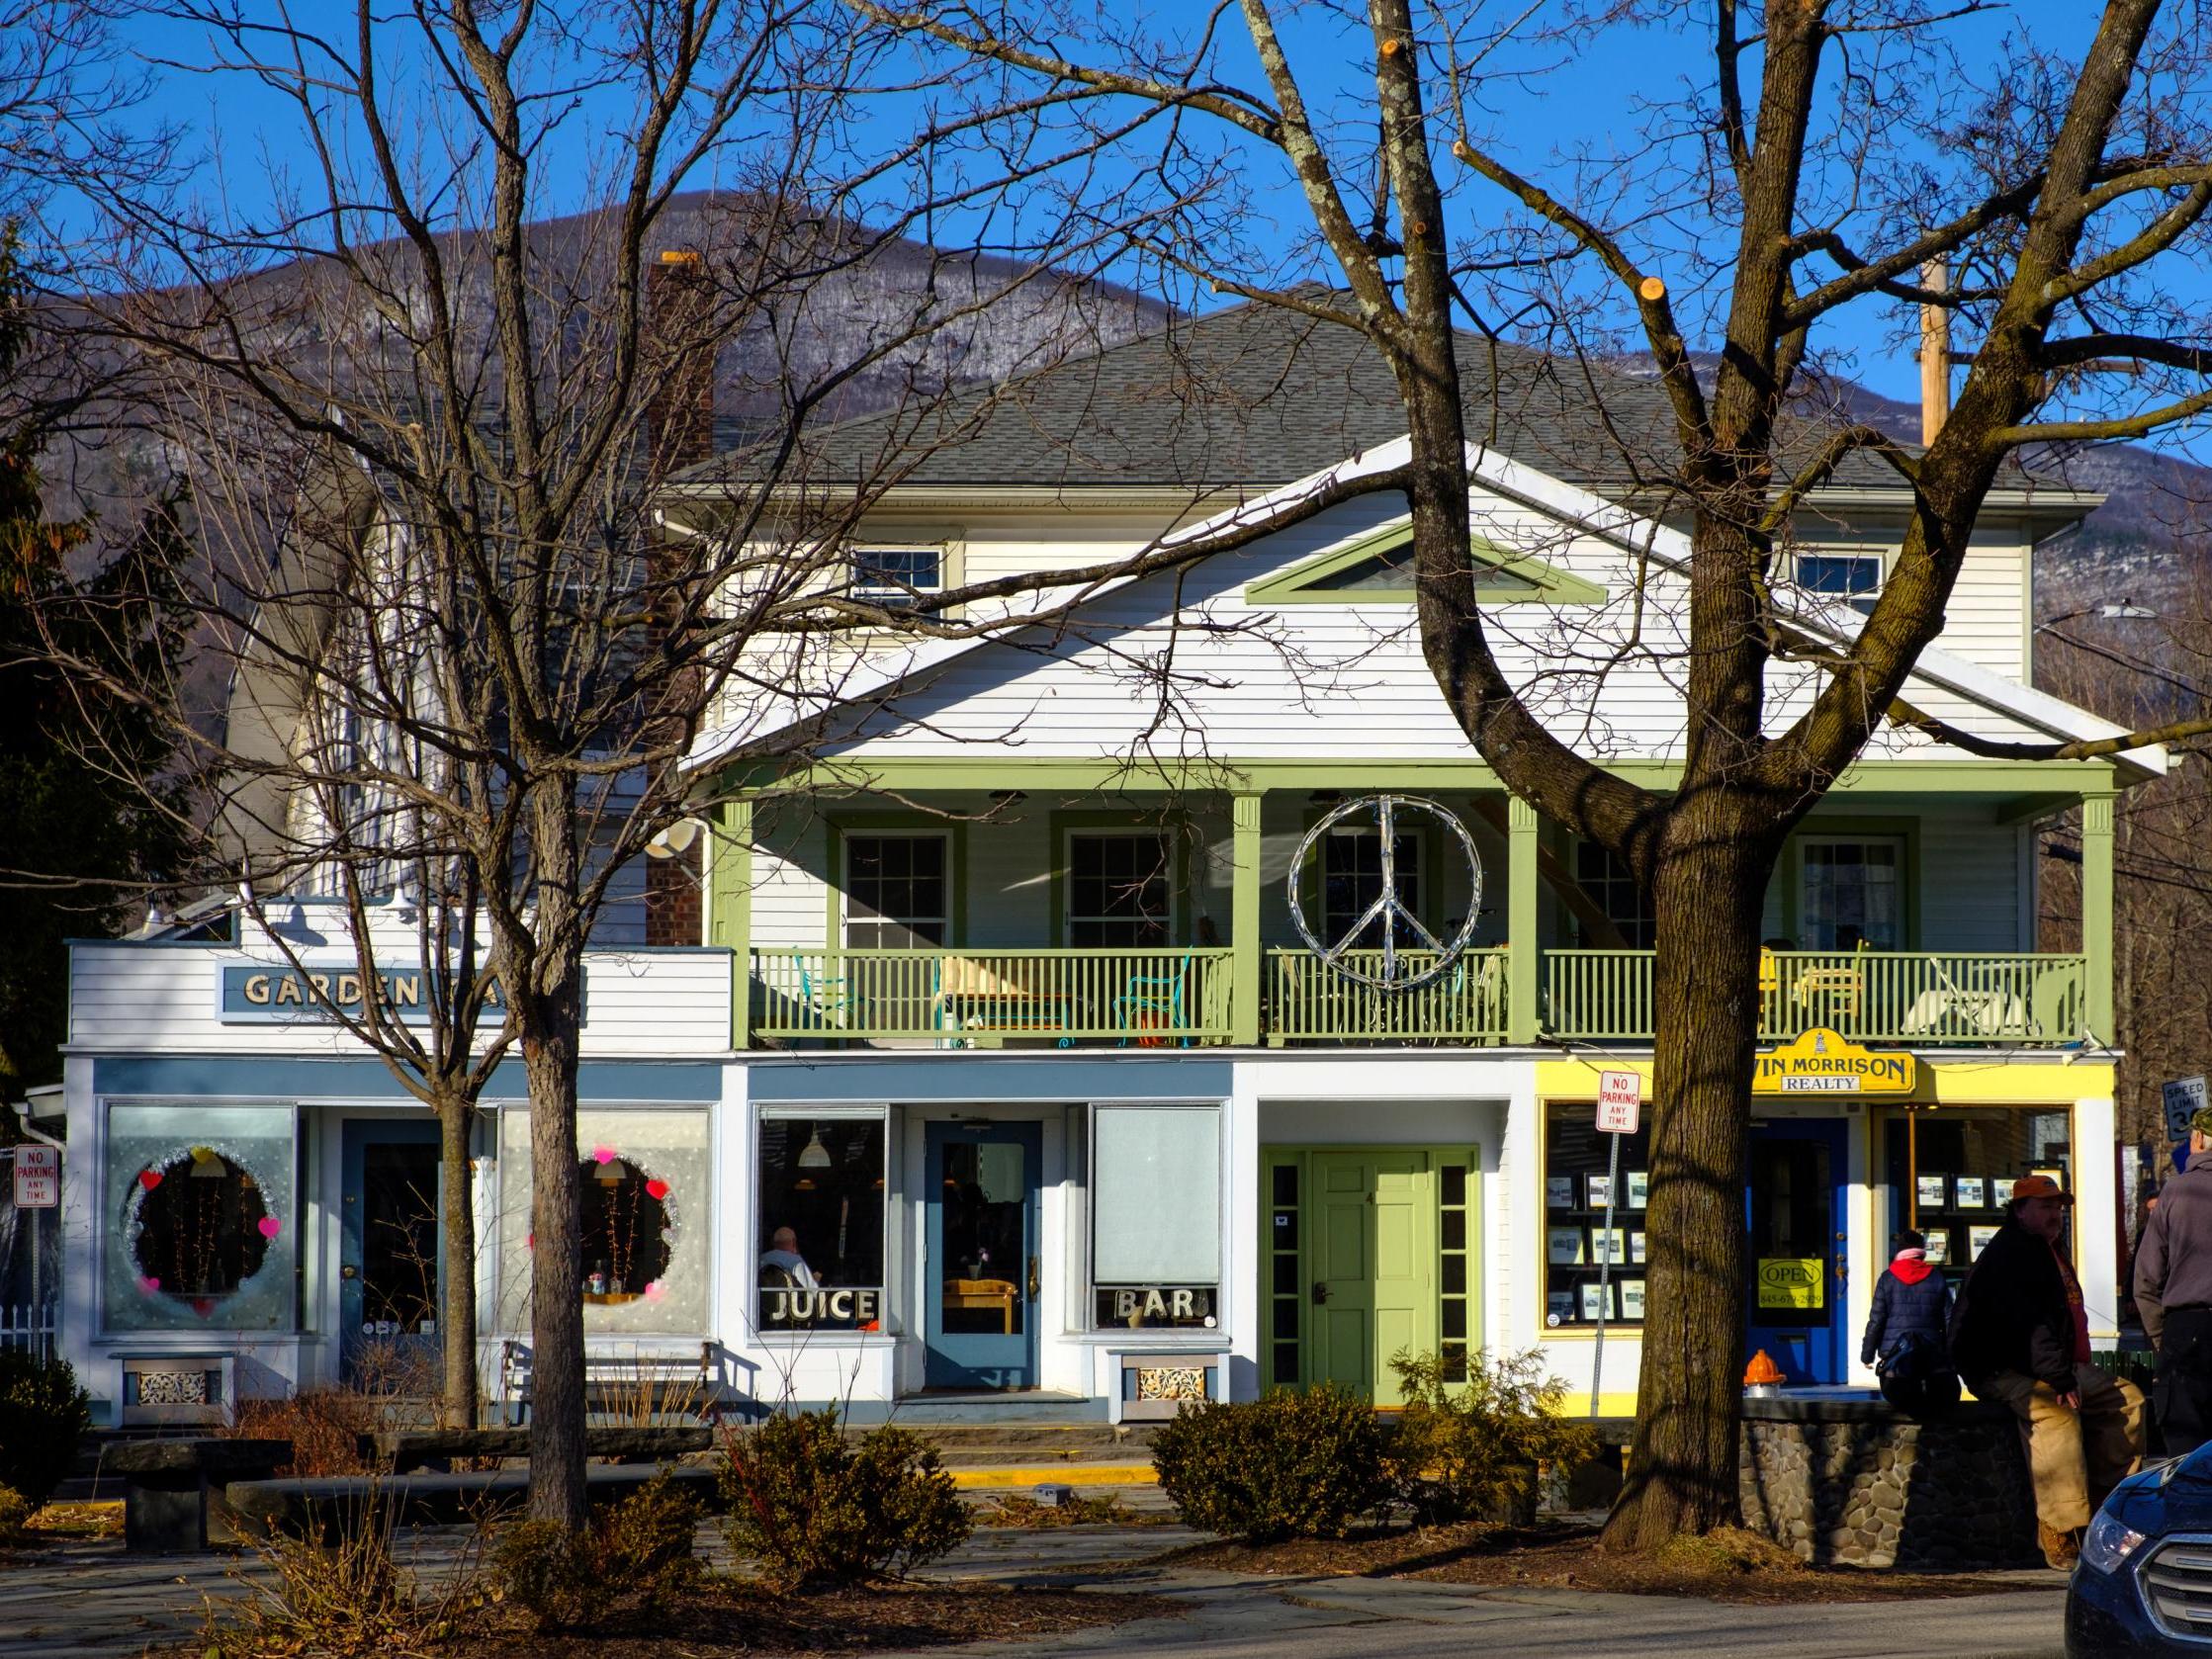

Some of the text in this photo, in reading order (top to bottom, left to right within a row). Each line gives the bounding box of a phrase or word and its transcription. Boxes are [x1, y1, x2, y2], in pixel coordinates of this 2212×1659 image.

[244, 975, 420, 1005] GARDN
[1754, 1058, 1905, 1085] IN MORRISON
[1613, 1078, 1628, 1090] NO
[1787, 1077, 1855, 1091] REALTY
[2167, 1083, 2204, 1099] SPEED
[1602, 1091, 1637, 1105] PARKING
[2171, 1095, 2201, 1110] LIMIT
[1610, 1105, 1627, 1115] ANY
[1608, 1116, 1628, 1126] TIME
[28, 1152, 44, 1164] NO
[17, 1166, 54, 1179] PARKING
[28, 1180, 44, 1189] ANY
[26, 1190, 46, 1200] TIME
[1766, 1266, 1814, 1282] OPEN
[771, 1288, 1194, 1321] JUICE BAR
